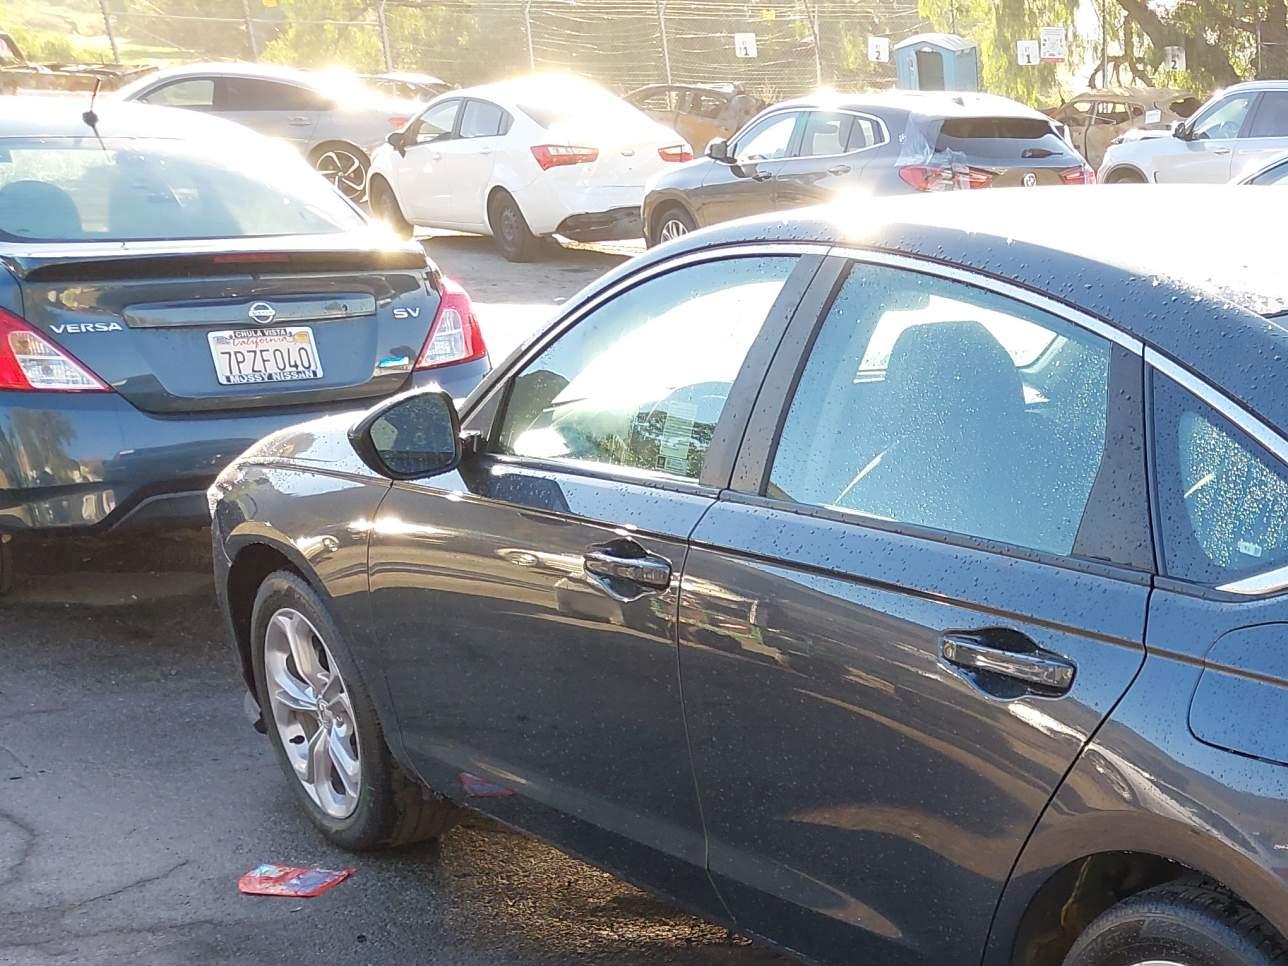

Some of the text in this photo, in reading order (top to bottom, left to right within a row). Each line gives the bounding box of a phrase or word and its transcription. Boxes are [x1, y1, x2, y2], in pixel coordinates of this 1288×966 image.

[1171, 59, 1178, 70] 2
[393, 307, 420, 319] SV
[49, 321, 123, 334] VERSA
[235, 328, 287, 338] CHULA VISTA
[220, 347, 312, 375] 7PZF040
[230, 370, 313, 383] MOSSY NISSAN
